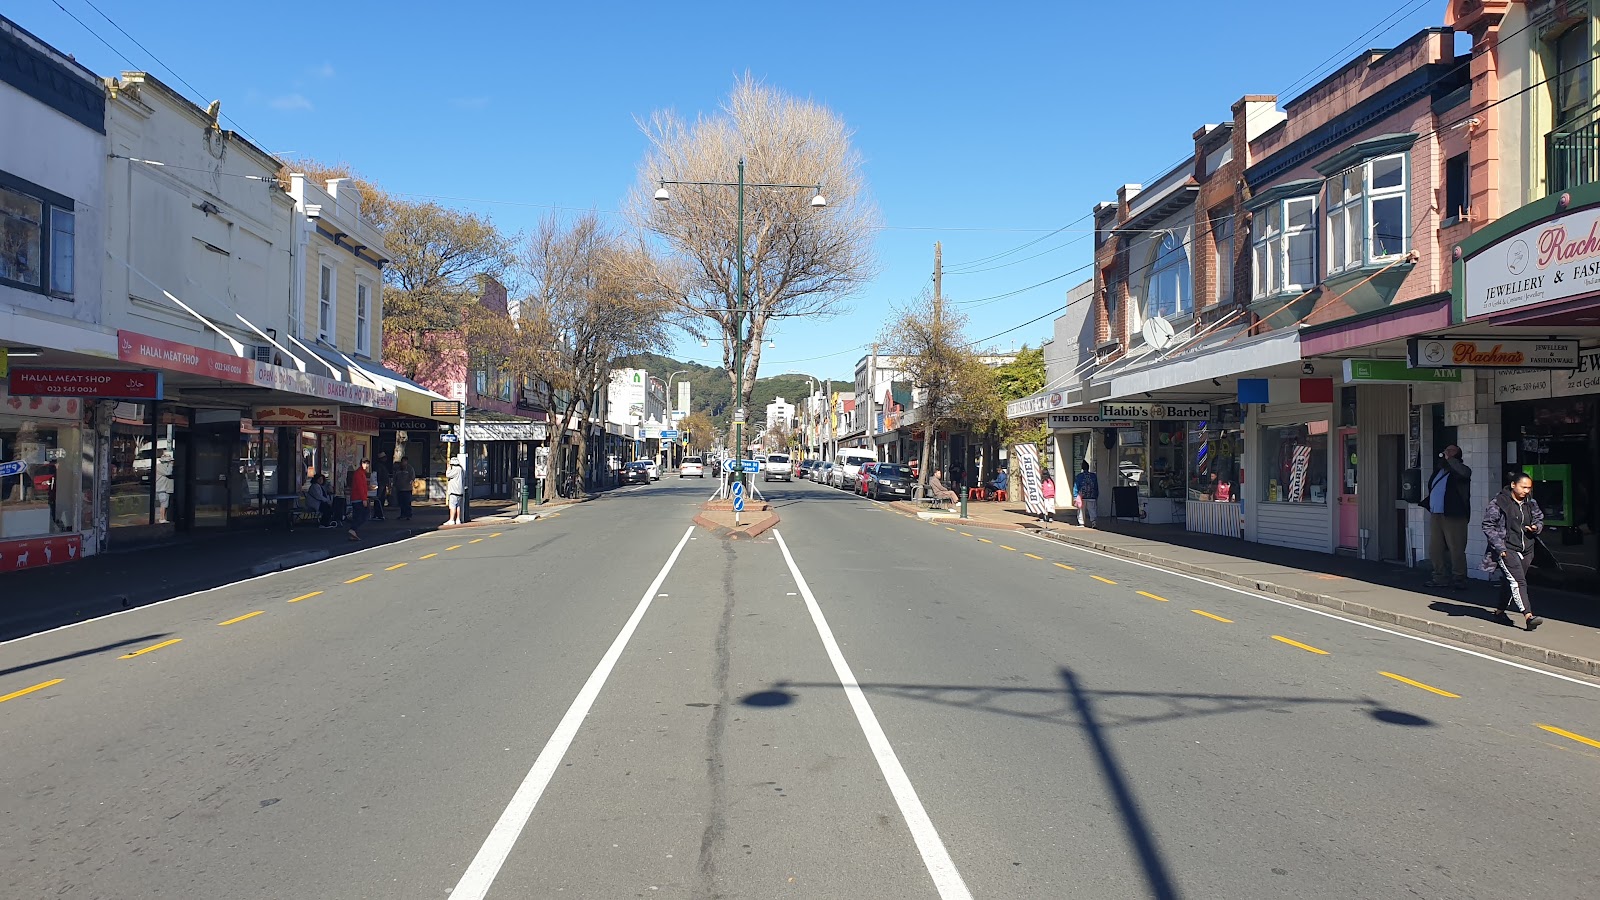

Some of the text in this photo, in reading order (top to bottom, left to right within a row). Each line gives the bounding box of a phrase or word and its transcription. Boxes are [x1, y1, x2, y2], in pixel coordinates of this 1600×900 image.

[1538, 220, 1600, 266] Rach
[1484, 275, 1545, 303] JEWELLERY
[1553, 270, 1565, 283] &
[140, 344, 162, 356] HALAL
[163, 350, 182, 362] MEAT
[182, 353, 199, 366] SHOP
[1453, 342, 1523, 364] Rachna's
[21, 374, 111, 383] HALAL MEAT SHOP
[1433, 369, 1456, 378] ATM
[327, 383, 348, 399] BAKERY
[1103, 405, 1148, 417] Habib's
[1167, 405, 1209, 417] Barber
[391, 420, 426, 429] México
